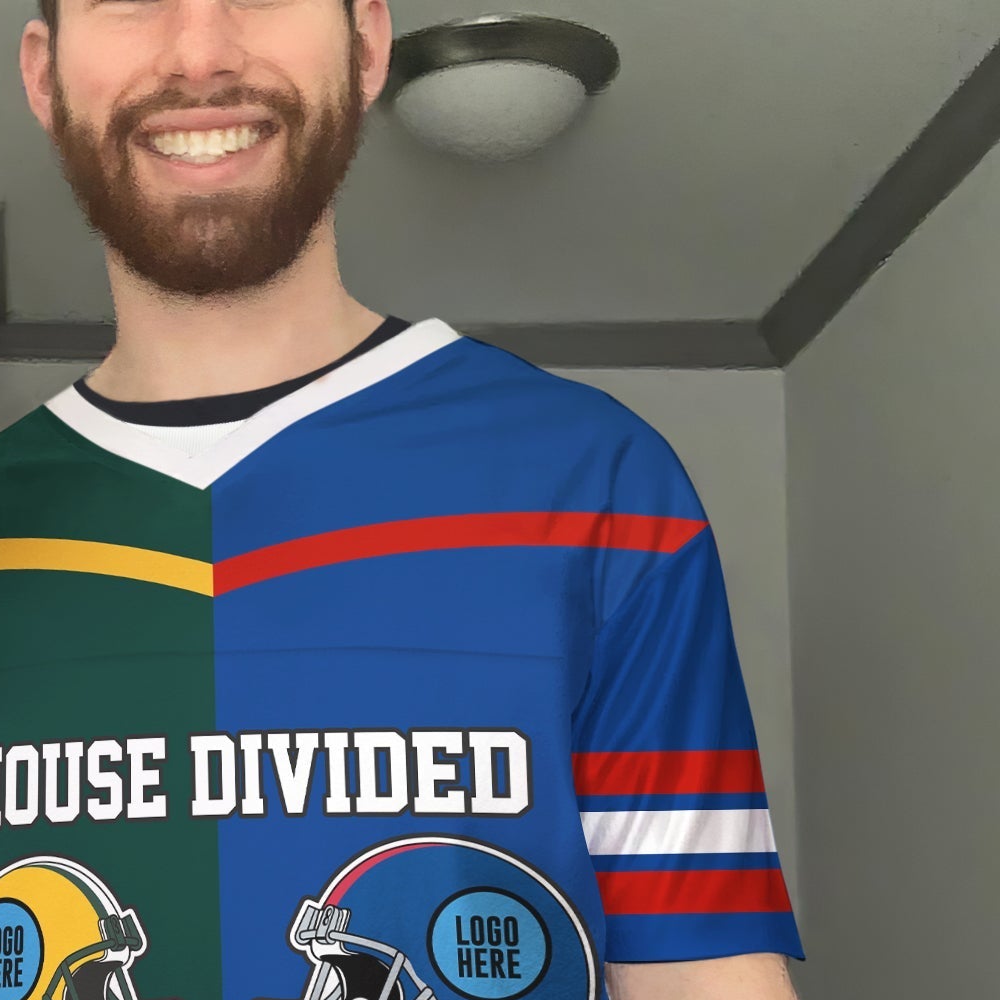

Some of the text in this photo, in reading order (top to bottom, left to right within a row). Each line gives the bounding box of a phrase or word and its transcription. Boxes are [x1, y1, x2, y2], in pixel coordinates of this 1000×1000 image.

[191, 731, 528, 815] DIVIDED
[456, 914, 520, 947] LOGO
[457, 947, 522, 980] HERE
